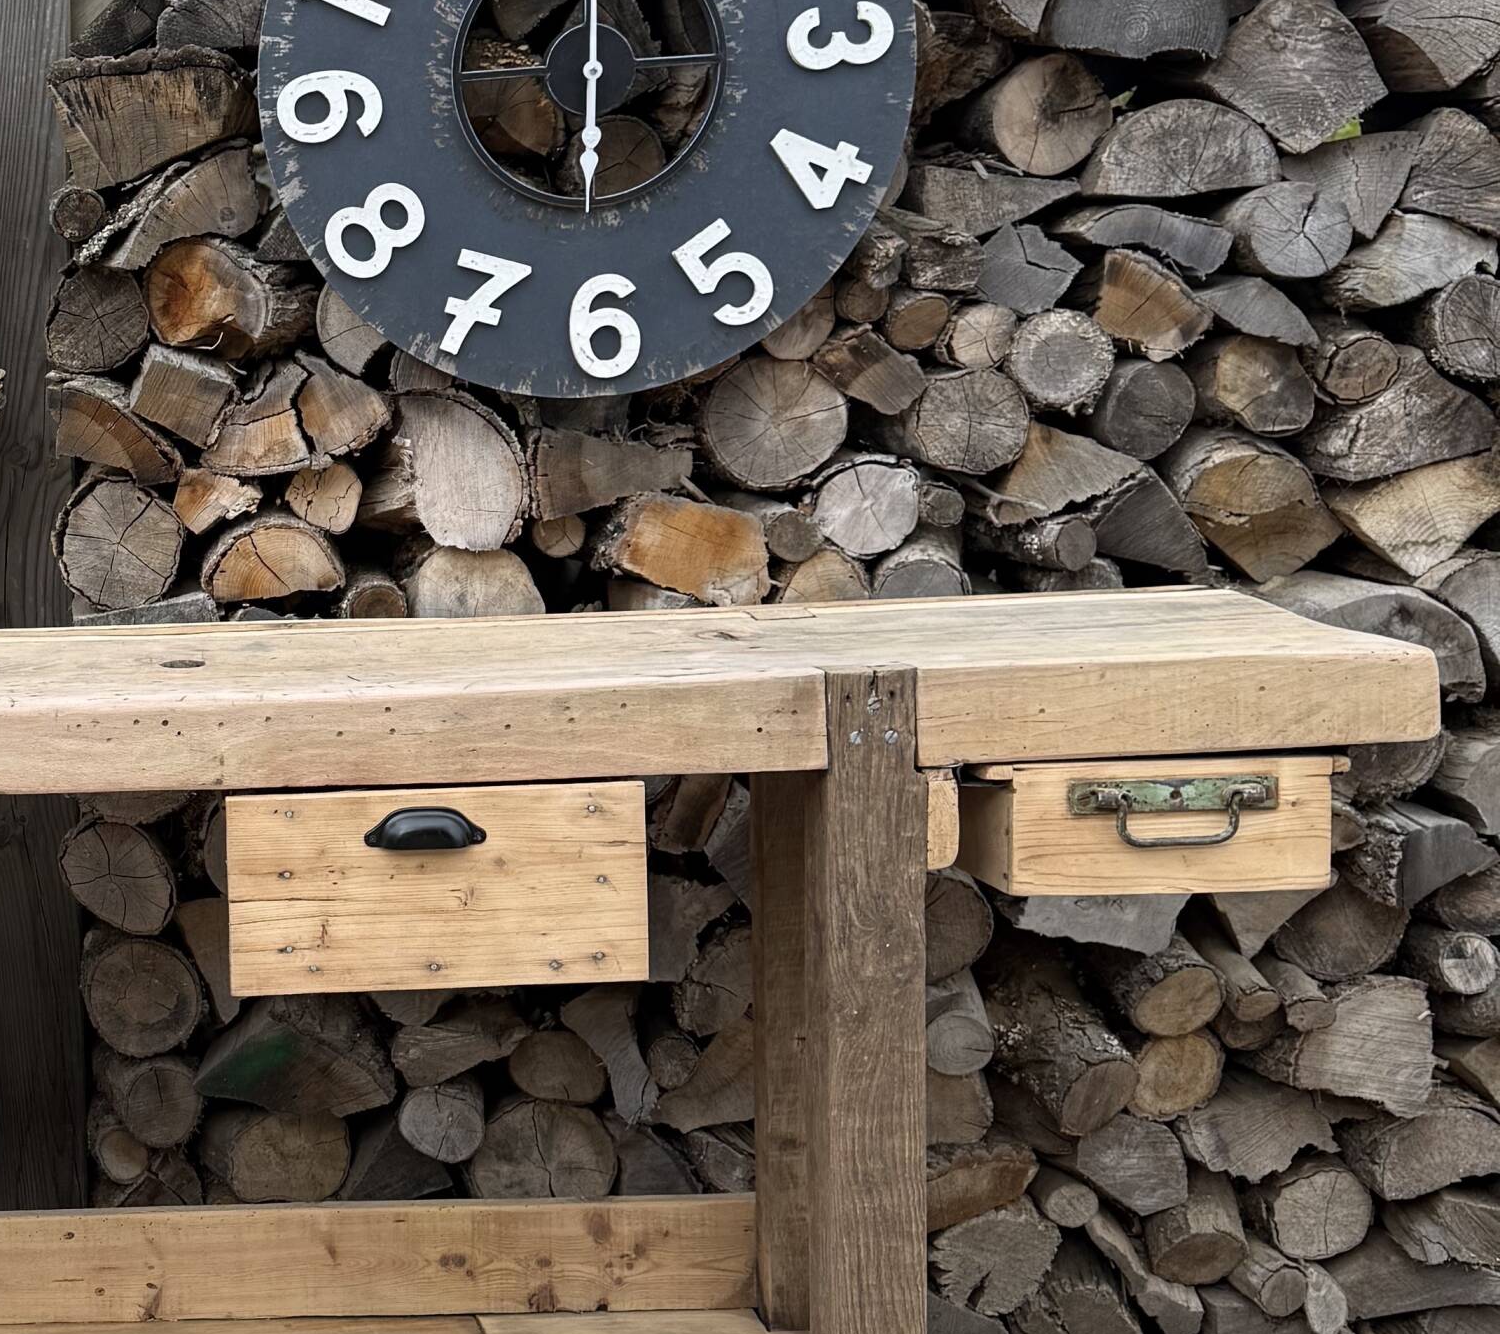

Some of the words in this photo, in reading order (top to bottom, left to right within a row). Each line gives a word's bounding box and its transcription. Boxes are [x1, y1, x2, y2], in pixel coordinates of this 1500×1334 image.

[786, 0, 896, 70] 3
[276, 69, 384, 144] 9
[769, 128, 875, 210] 4
[324, 182, 427, 279] 8
[670, 218, 775, 326] 5
[438, 248, 533, 355] 7
[568, 273, 642, 379] 6
